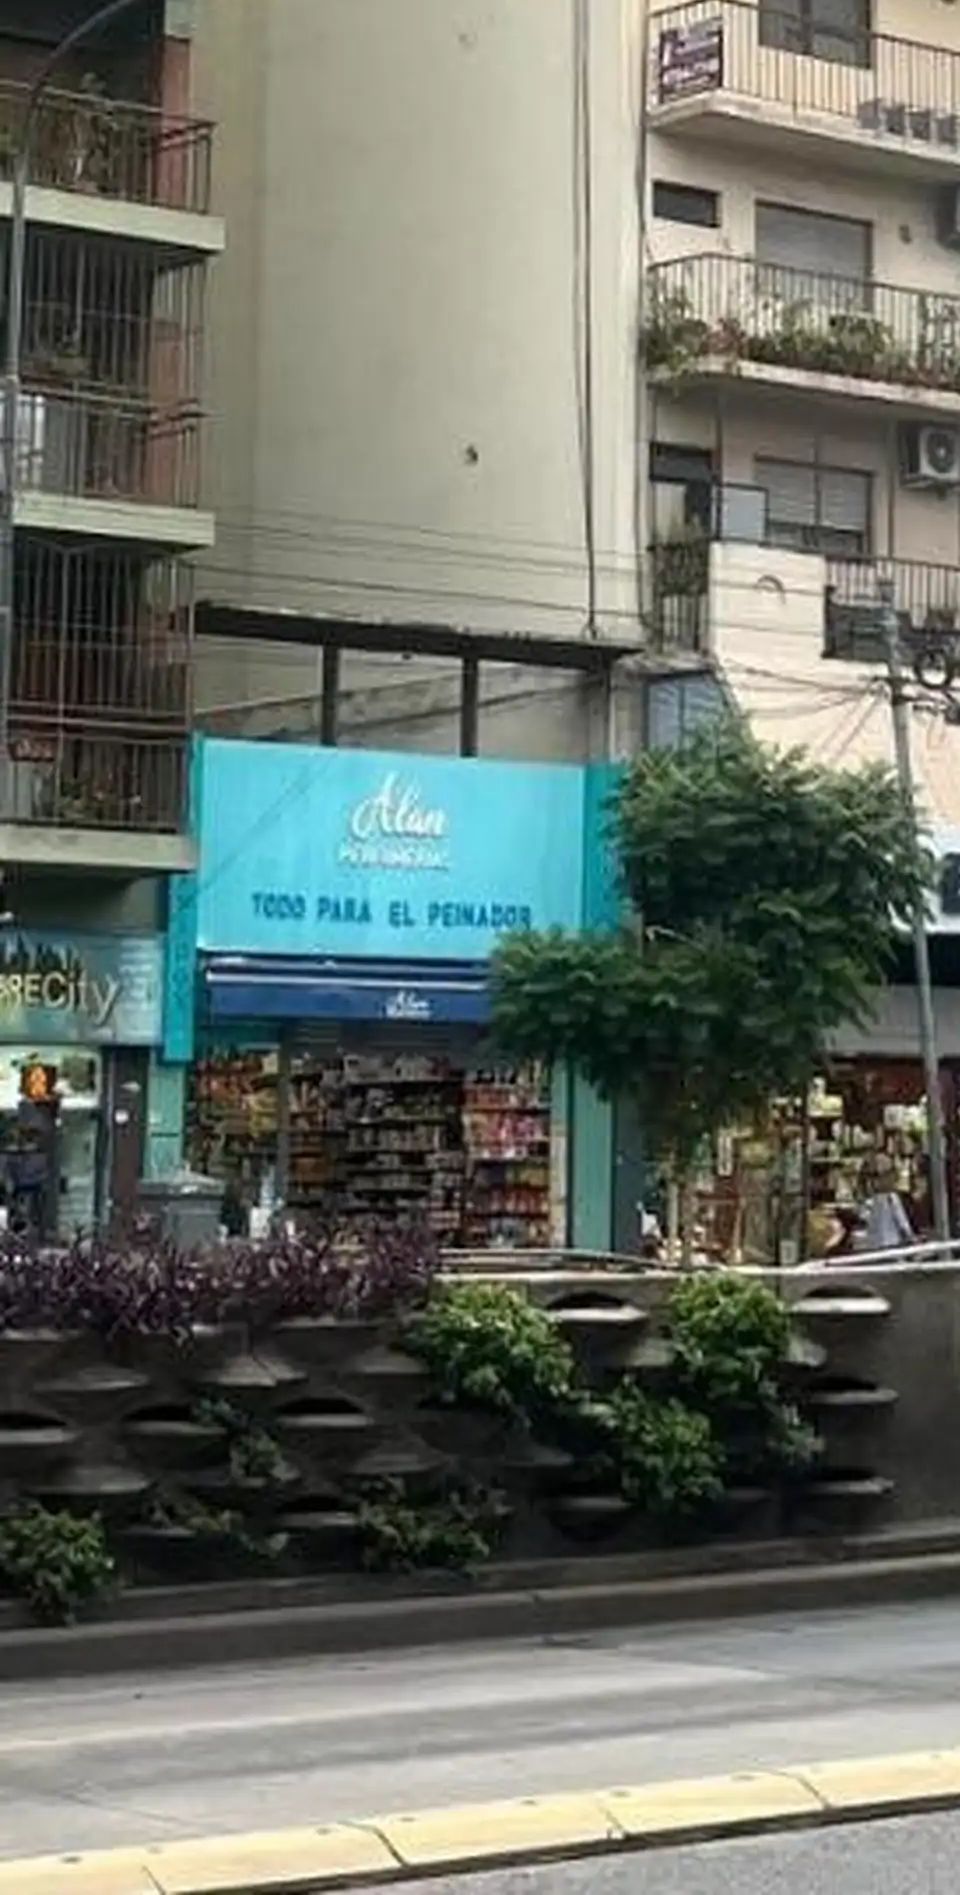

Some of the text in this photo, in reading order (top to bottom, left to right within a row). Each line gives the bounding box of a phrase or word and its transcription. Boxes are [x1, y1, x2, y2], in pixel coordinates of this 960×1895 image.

[349, 769, 447, 838] Alan
[252, 892, 532, 931] TODO PARA EL PEINADOR
